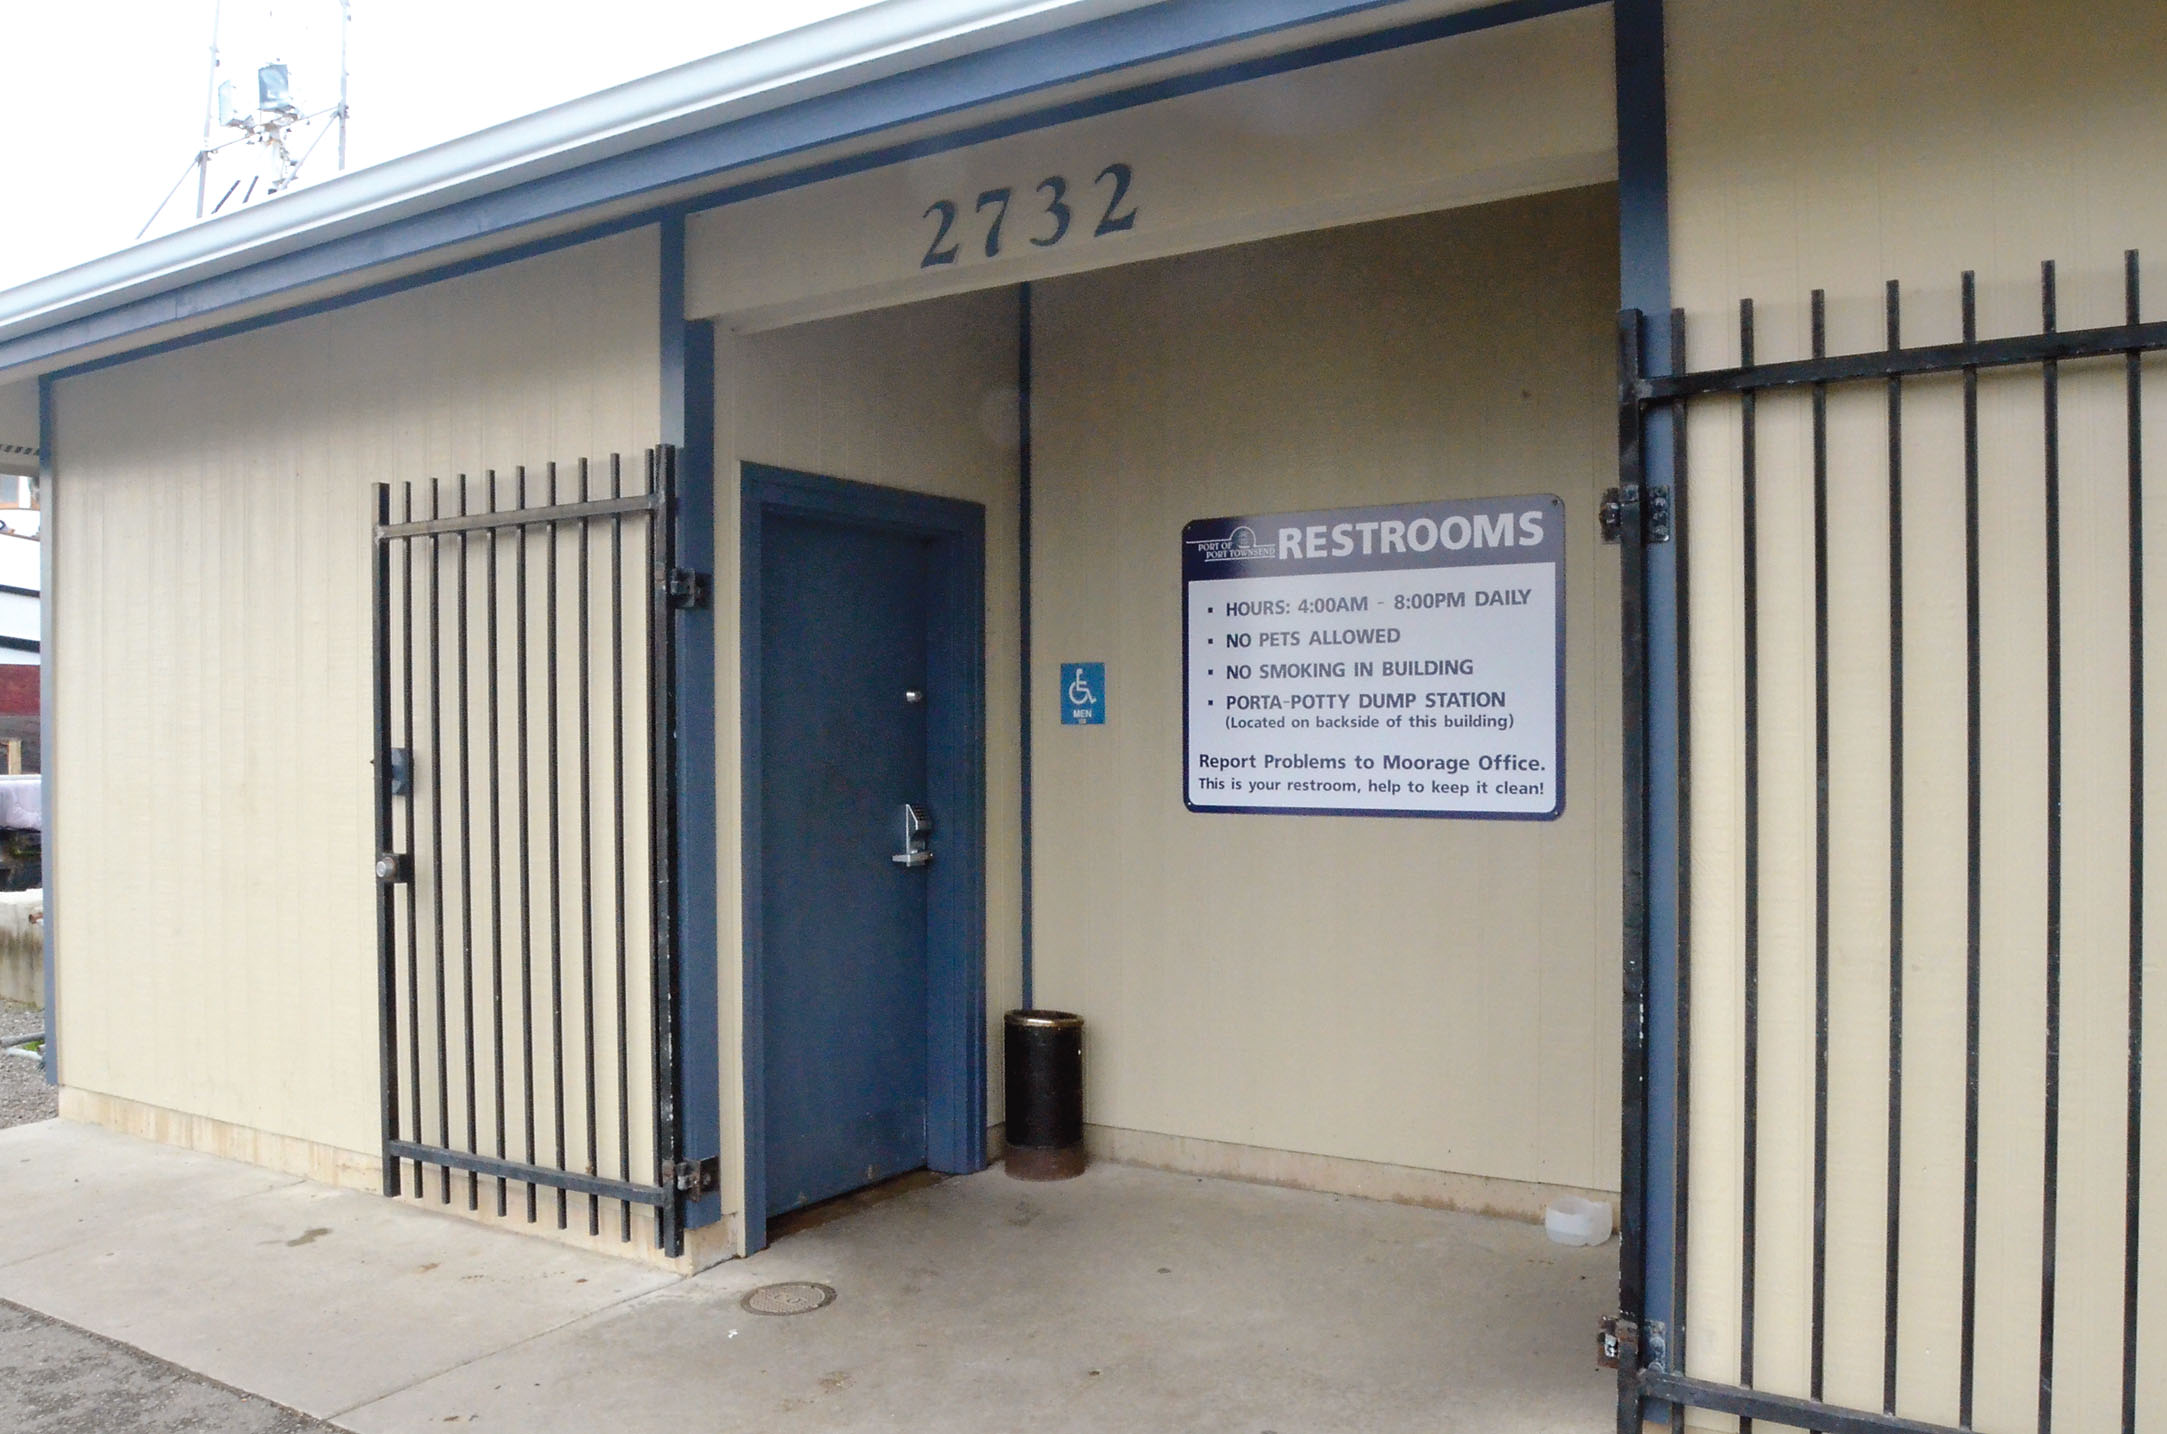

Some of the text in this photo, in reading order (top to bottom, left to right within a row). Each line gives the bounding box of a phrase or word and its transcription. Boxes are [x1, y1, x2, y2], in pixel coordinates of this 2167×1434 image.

[920, 163, 1138, 269] 2732
[1278, 511, 1544, 559] RESTROOMS
[1198, 543, 1219, 552] PORT
[1206, 547, 1275, 559] PORT TOWNSEND
[1226, 600, 1291, 616] HOURS:
[1298, 597, 1368, 613] 4:00AM
[1394, 592, 1466, 610] 8:00PM
[1475, 589, 1532, 607] DAILY
[1226, 628, 1400, 648] NO PETS ALLOWED
[1226, 659, 1474, 679] NO SMOKING IN BUILDING
[1226, 692, 1505, 710] PORTA-POTTY DUMP STATION
[1073, 709, 1092, 718] MEN
[1225, 714, 1514, 730] (Located on backside of this building)
[1199, 754, 1545, 773] Report Problems to Moorage Office.
[1199, 778, 1544, 796] This is your restroom, help to keep it clean!
